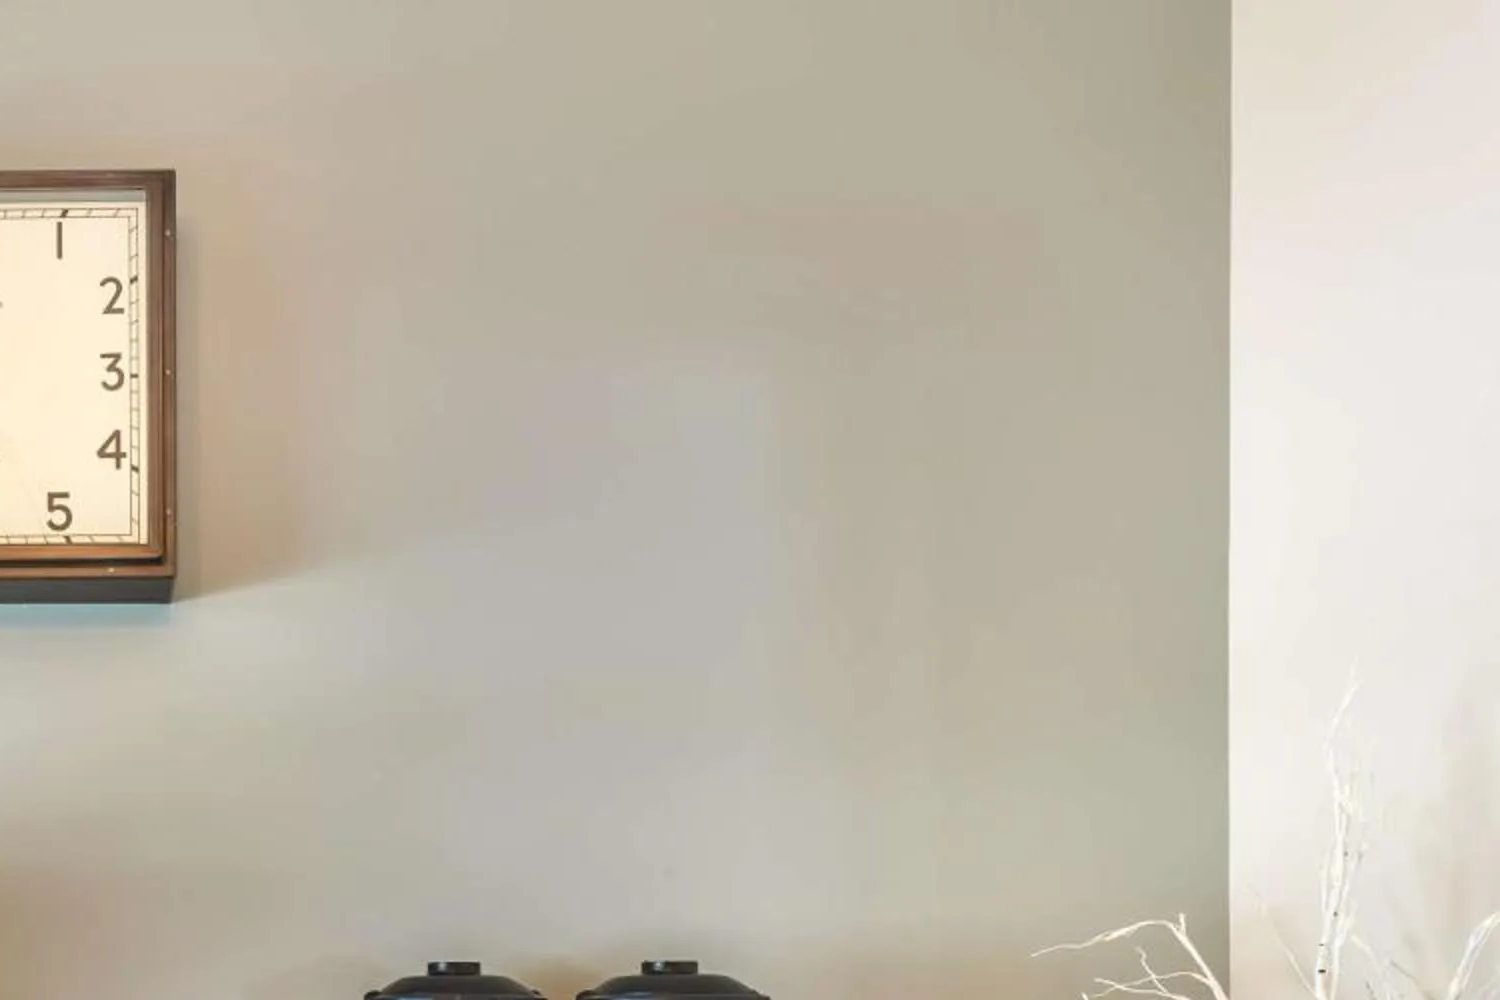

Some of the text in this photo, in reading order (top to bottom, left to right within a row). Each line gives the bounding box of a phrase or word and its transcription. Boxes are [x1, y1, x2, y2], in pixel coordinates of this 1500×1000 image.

[56, 221, 64, 260] 1
[99, 276, 125, 315] 2
[99, 352, 125, 392] 3
[97, 429, 127, 470] 4
[47, 491, 73, 532] 5
